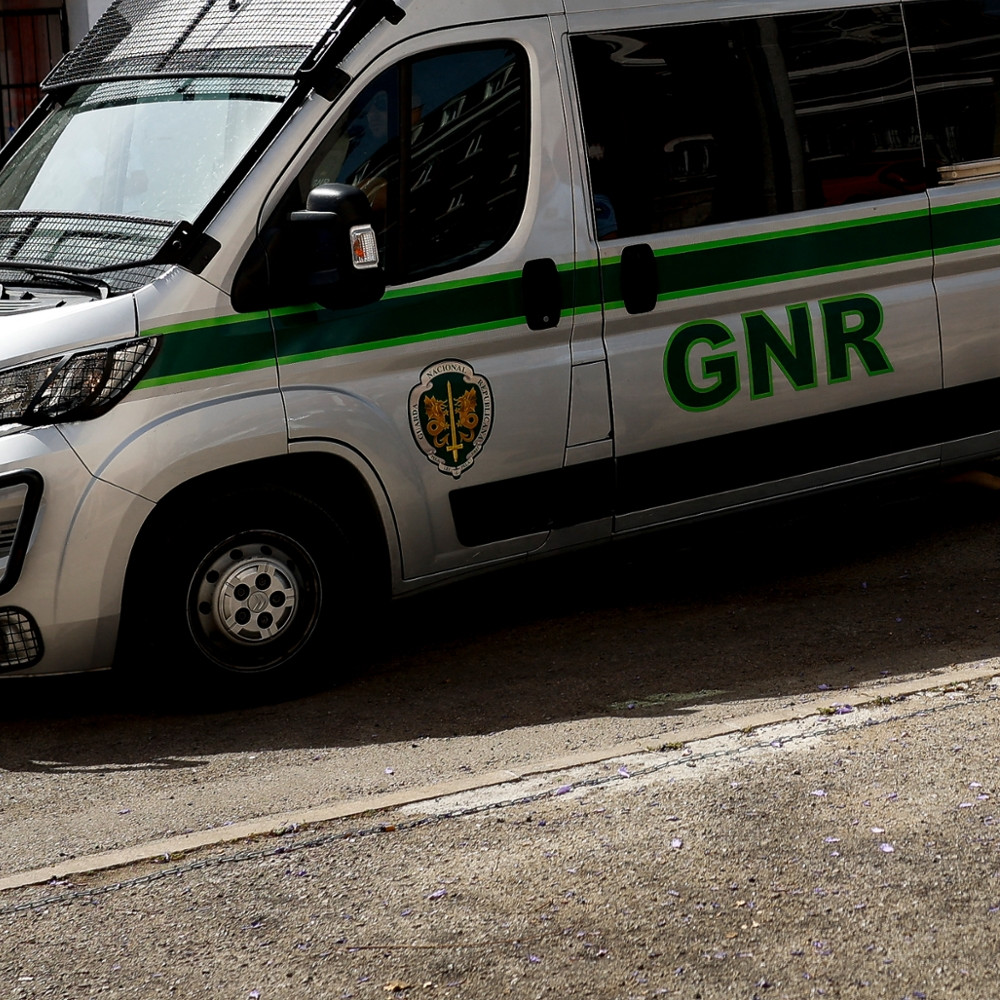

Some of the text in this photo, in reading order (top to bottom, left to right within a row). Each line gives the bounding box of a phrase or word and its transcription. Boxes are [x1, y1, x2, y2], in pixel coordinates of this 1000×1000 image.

[426, 364, 467, 379] NACIONAL
[663, 293, 894, 412] GNR
[412, 403, 424, 440] GUARDA
[477, 379, 492, 440] REPUBLICANA
